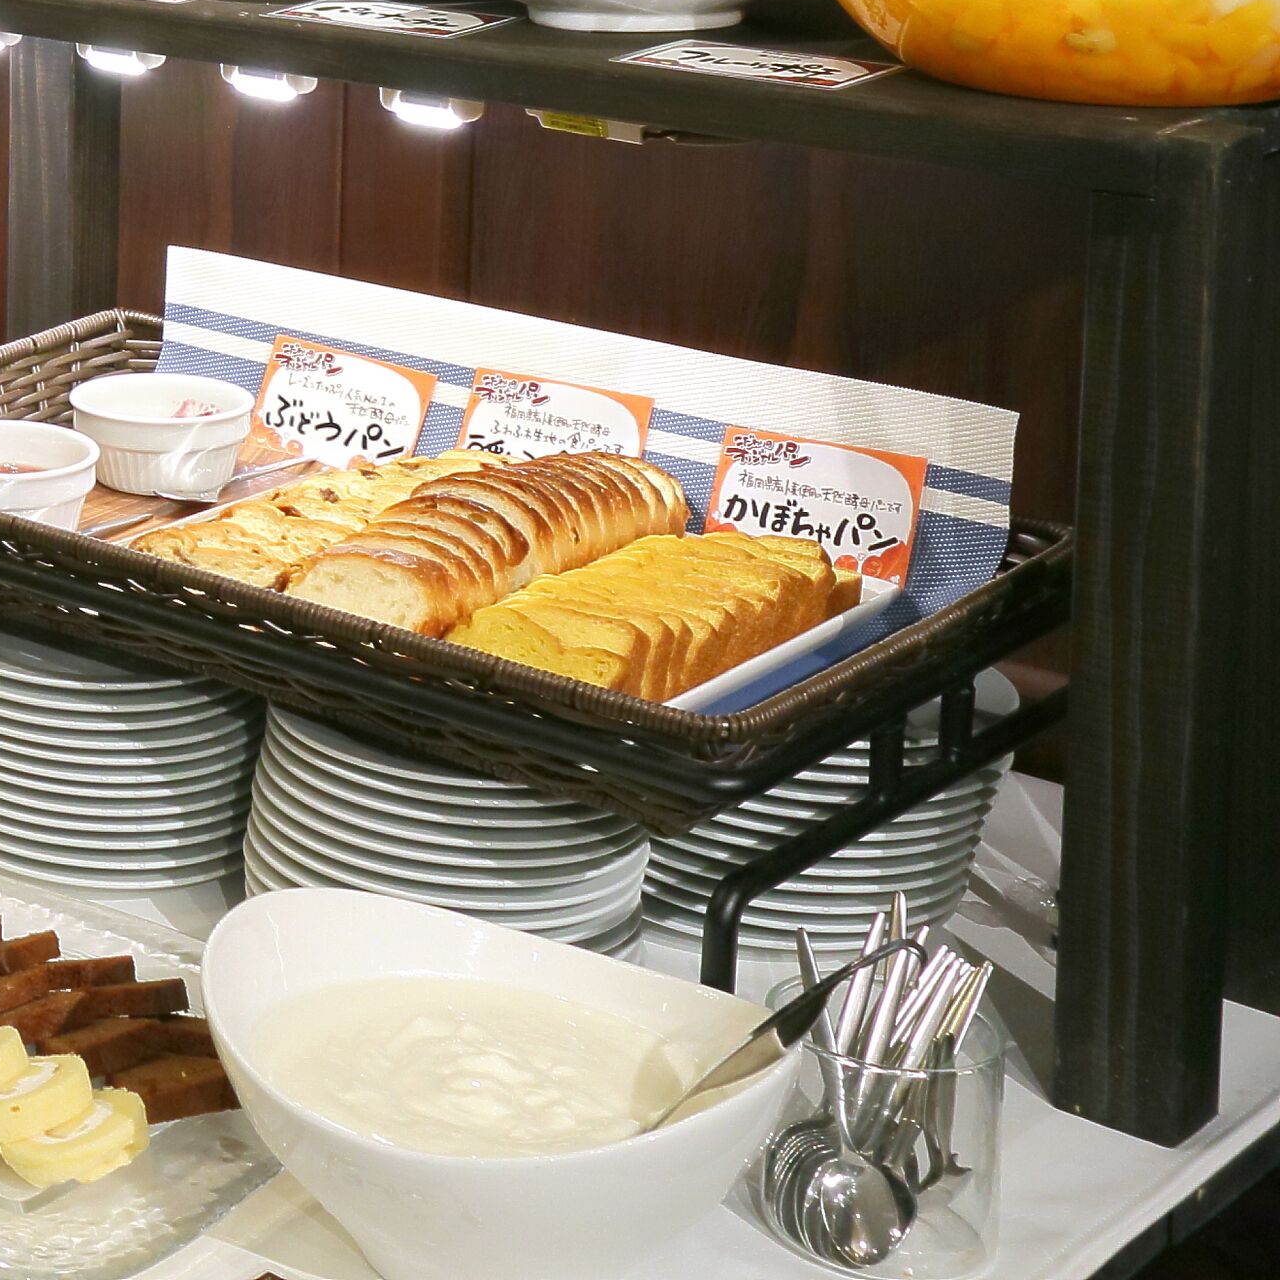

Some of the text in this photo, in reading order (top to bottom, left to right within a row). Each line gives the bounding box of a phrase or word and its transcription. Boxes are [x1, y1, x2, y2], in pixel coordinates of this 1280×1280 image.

[316, 354, 343, 376] パン
[520, 382, 550, 405] パン
[266, 395, 405, 458] ぶどうパン
[726, 442, 810, 467] オリジナル パン
[723, 494, 899, 551] かぼちゃパン
